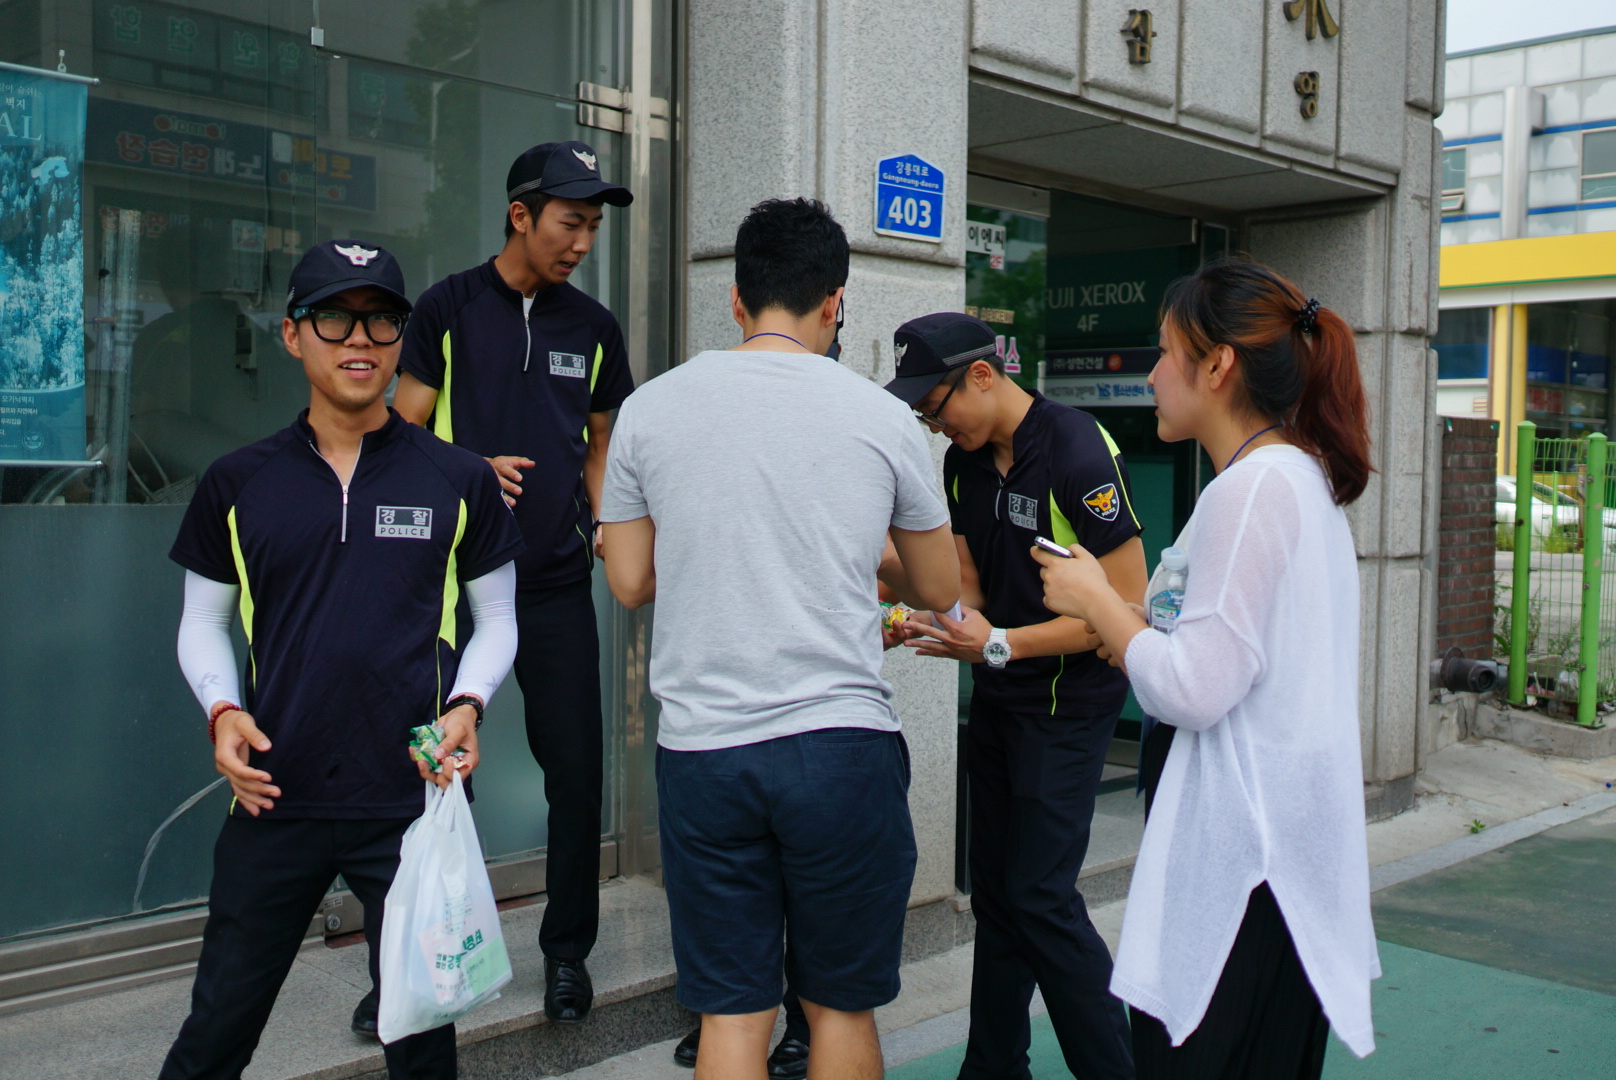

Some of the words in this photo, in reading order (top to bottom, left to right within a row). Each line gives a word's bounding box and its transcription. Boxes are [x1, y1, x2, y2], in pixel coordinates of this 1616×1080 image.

[1294, 71, 1320, 119] 영
[5, 97, 26, 110] 벽지
[895, 161, 929, 177] 강릉대로
[882, 172, 940, 189] Gangneung-daero
[888, 195, 932, 229] 403
[968, 226, 1006, 252] 이엔씨
[990, 255, 1002, 267] 2F
[1080, 281, 1146, 307] XEROX
[1077, 314, 1099, 332] 4F
[553, 367, 582, 376] POLICE
[1010, 514, 1034, 528] POLICE
[380, 527, 425, 536] POLICE
